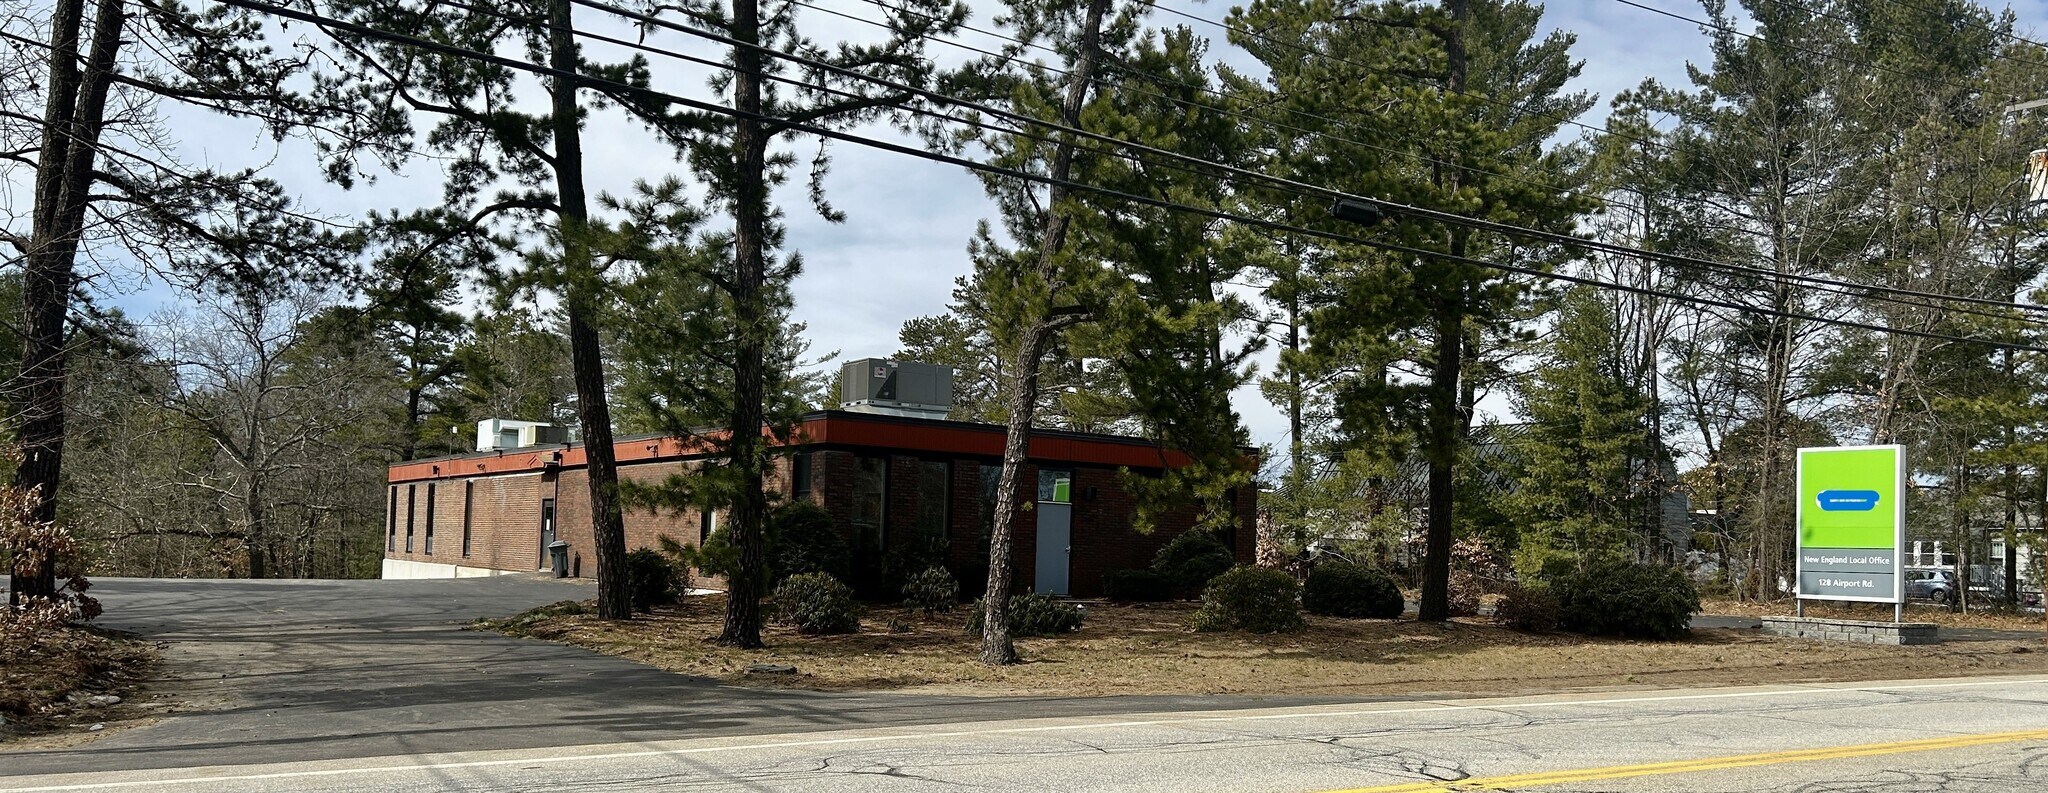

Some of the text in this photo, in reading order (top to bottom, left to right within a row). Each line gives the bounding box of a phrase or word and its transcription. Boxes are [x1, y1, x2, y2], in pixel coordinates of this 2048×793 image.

[1821, 556, 1847, 565] England
[1849, 556, 1867, 564] Local
[1869, 556, 1890, 565] Office
[1833, 579, 1860, 588] Airport
[1862, 580, 1875, 588] Rd.
